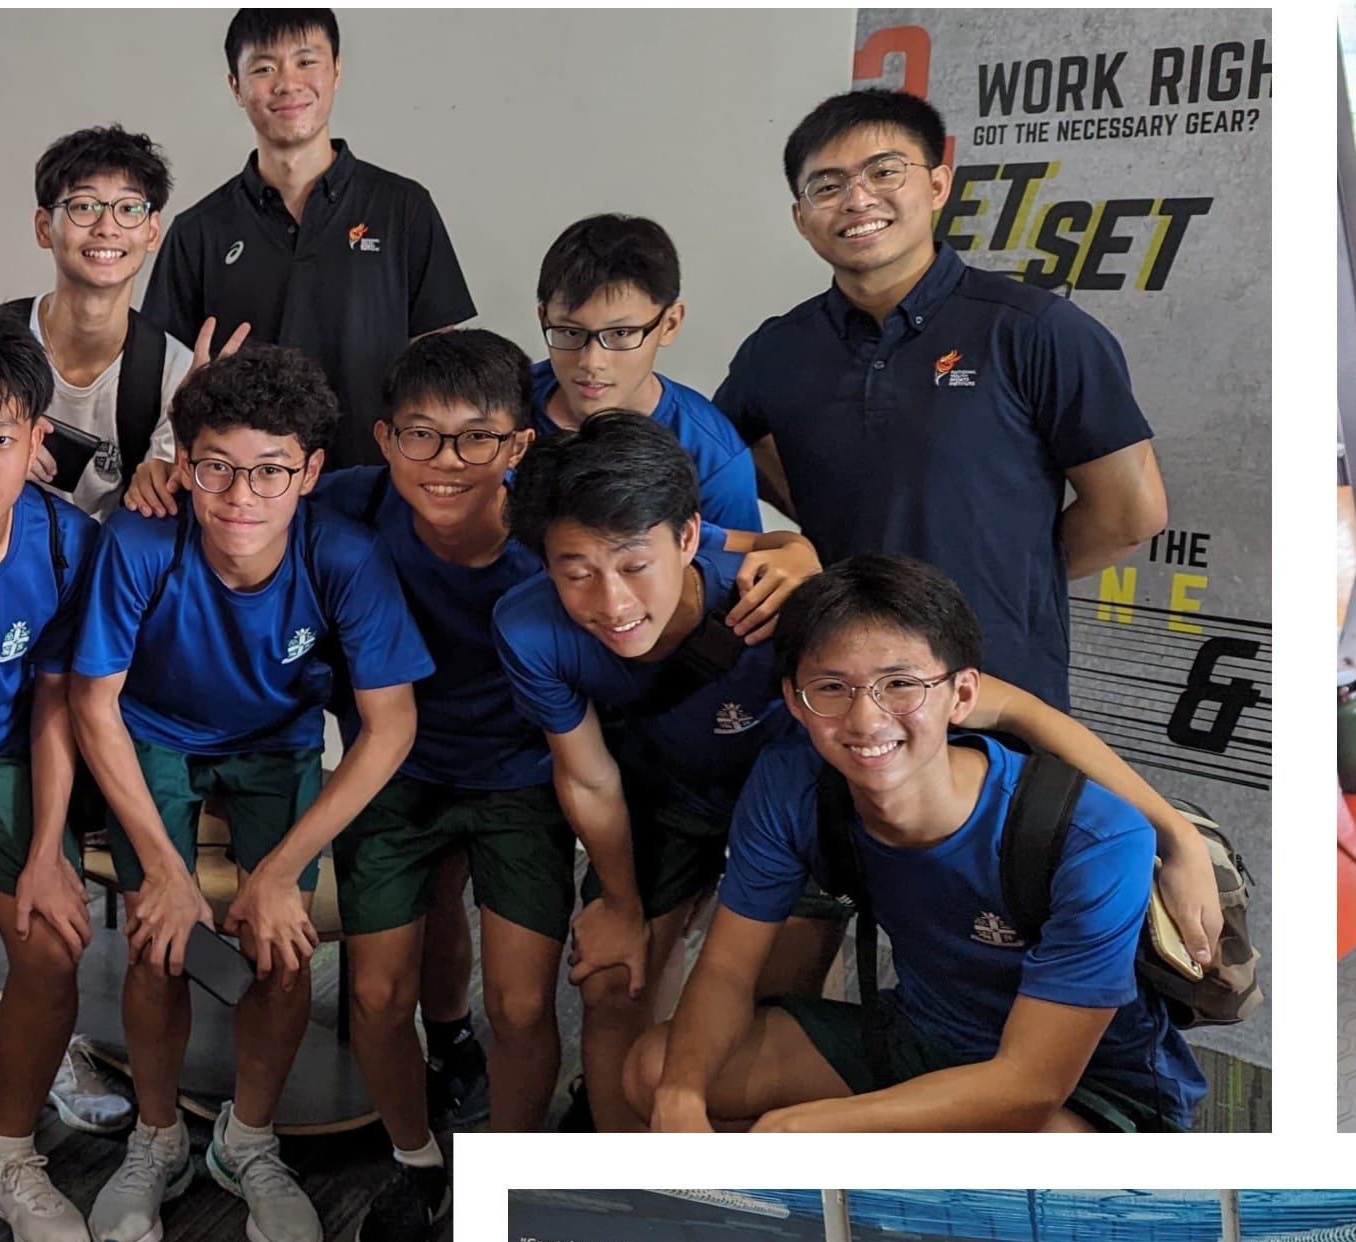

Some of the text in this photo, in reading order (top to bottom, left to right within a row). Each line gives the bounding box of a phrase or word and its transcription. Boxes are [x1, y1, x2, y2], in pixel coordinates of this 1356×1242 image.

[978, 52, 1128, 118] WORK
[973, 108, 1261, 147] GOT THE NECESSARY GEAR?
[935, 161, 1214, 292] ET SET
[1149, 529, 1211, 568] THE
